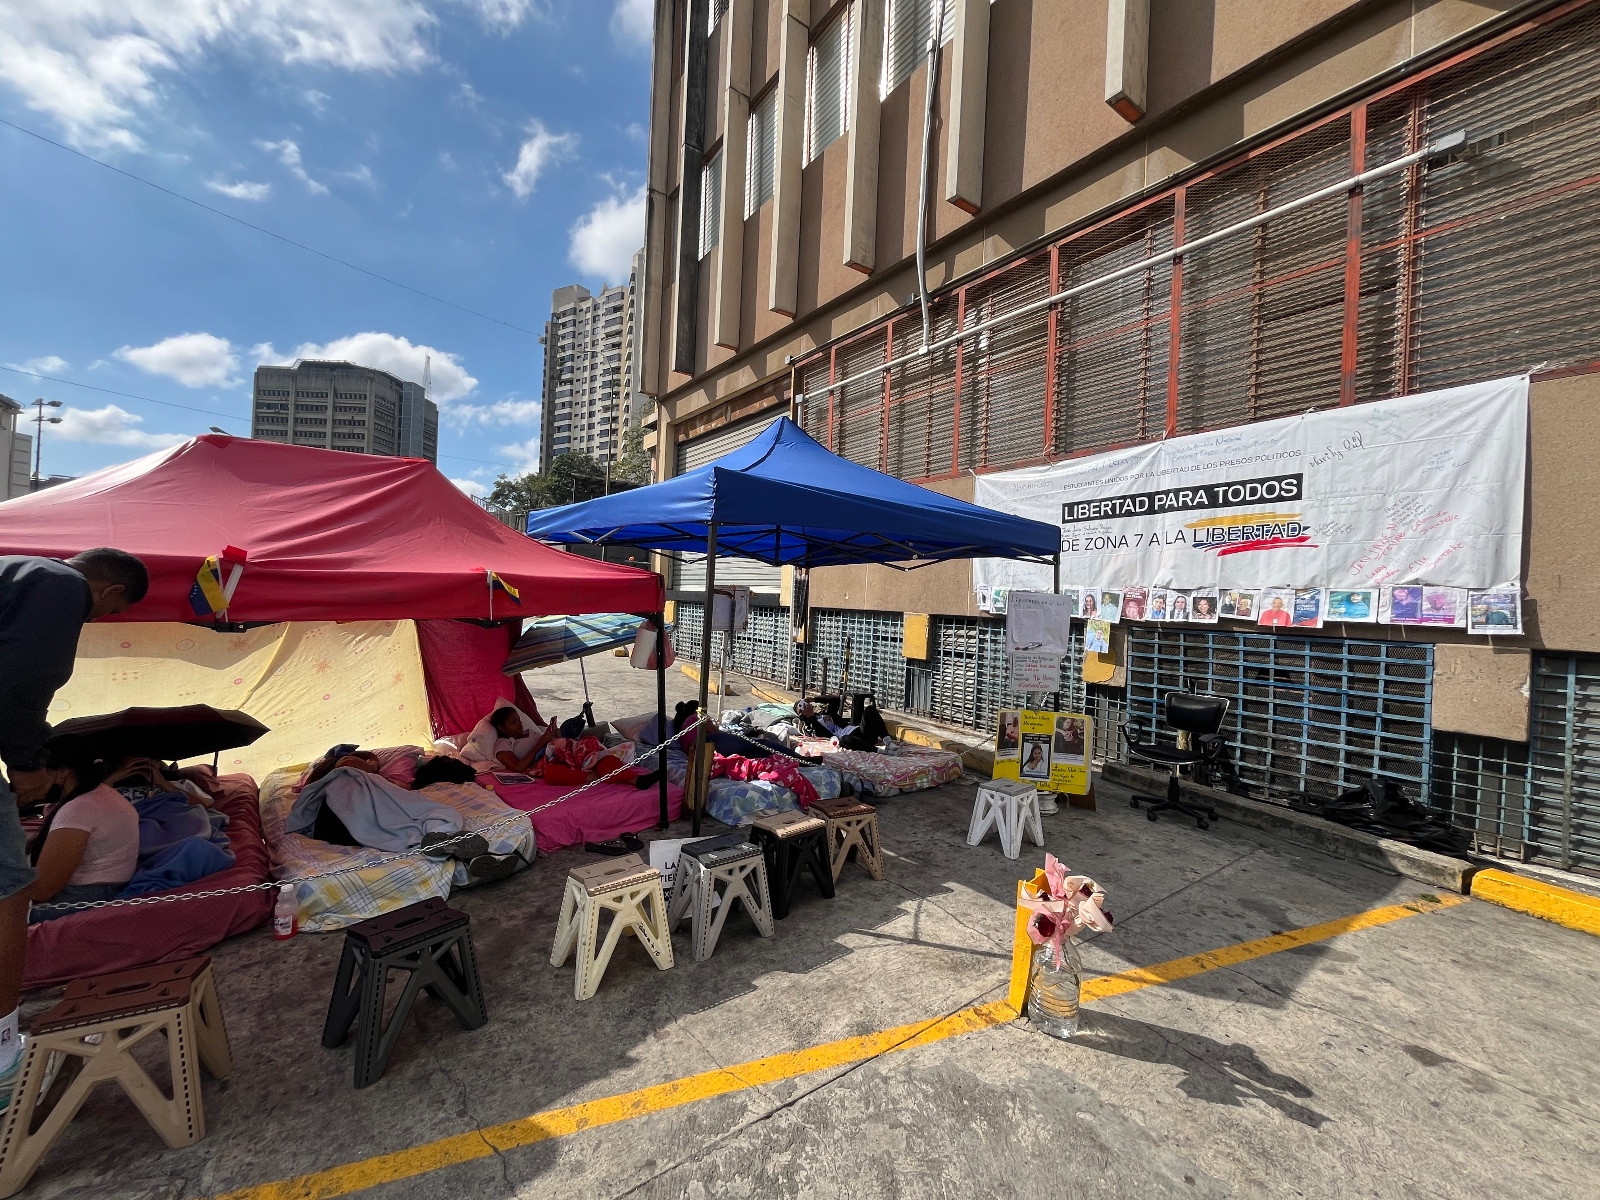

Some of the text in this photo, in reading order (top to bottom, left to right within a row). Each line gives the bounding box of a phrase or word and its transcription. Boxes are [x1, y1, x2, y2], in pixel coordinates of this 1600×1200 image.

[1104, 475, 1129, 485] UNIDOS
[1130, 472, 1145, 480] POR
[1190, 463, 1201, 471] DE
[1203, 461, 1219, 470] LOS
[1219, 456, 1254, 468] PRESOS
[1254, 449, 1303, 463] POLITICOS
[1064, 478, 1299, 521] LIBERTAD PARA TODOS
[1061, 538, 1080, 553] DE
[1084, 534, 1130, 551] ZONA
[1133, 532, 1145, 548] 7
[1148, 531, 1161, 547] A
[1165, 528, 1187, 545] LA
[1193, 520, 1303, 544] LIBERTAD
